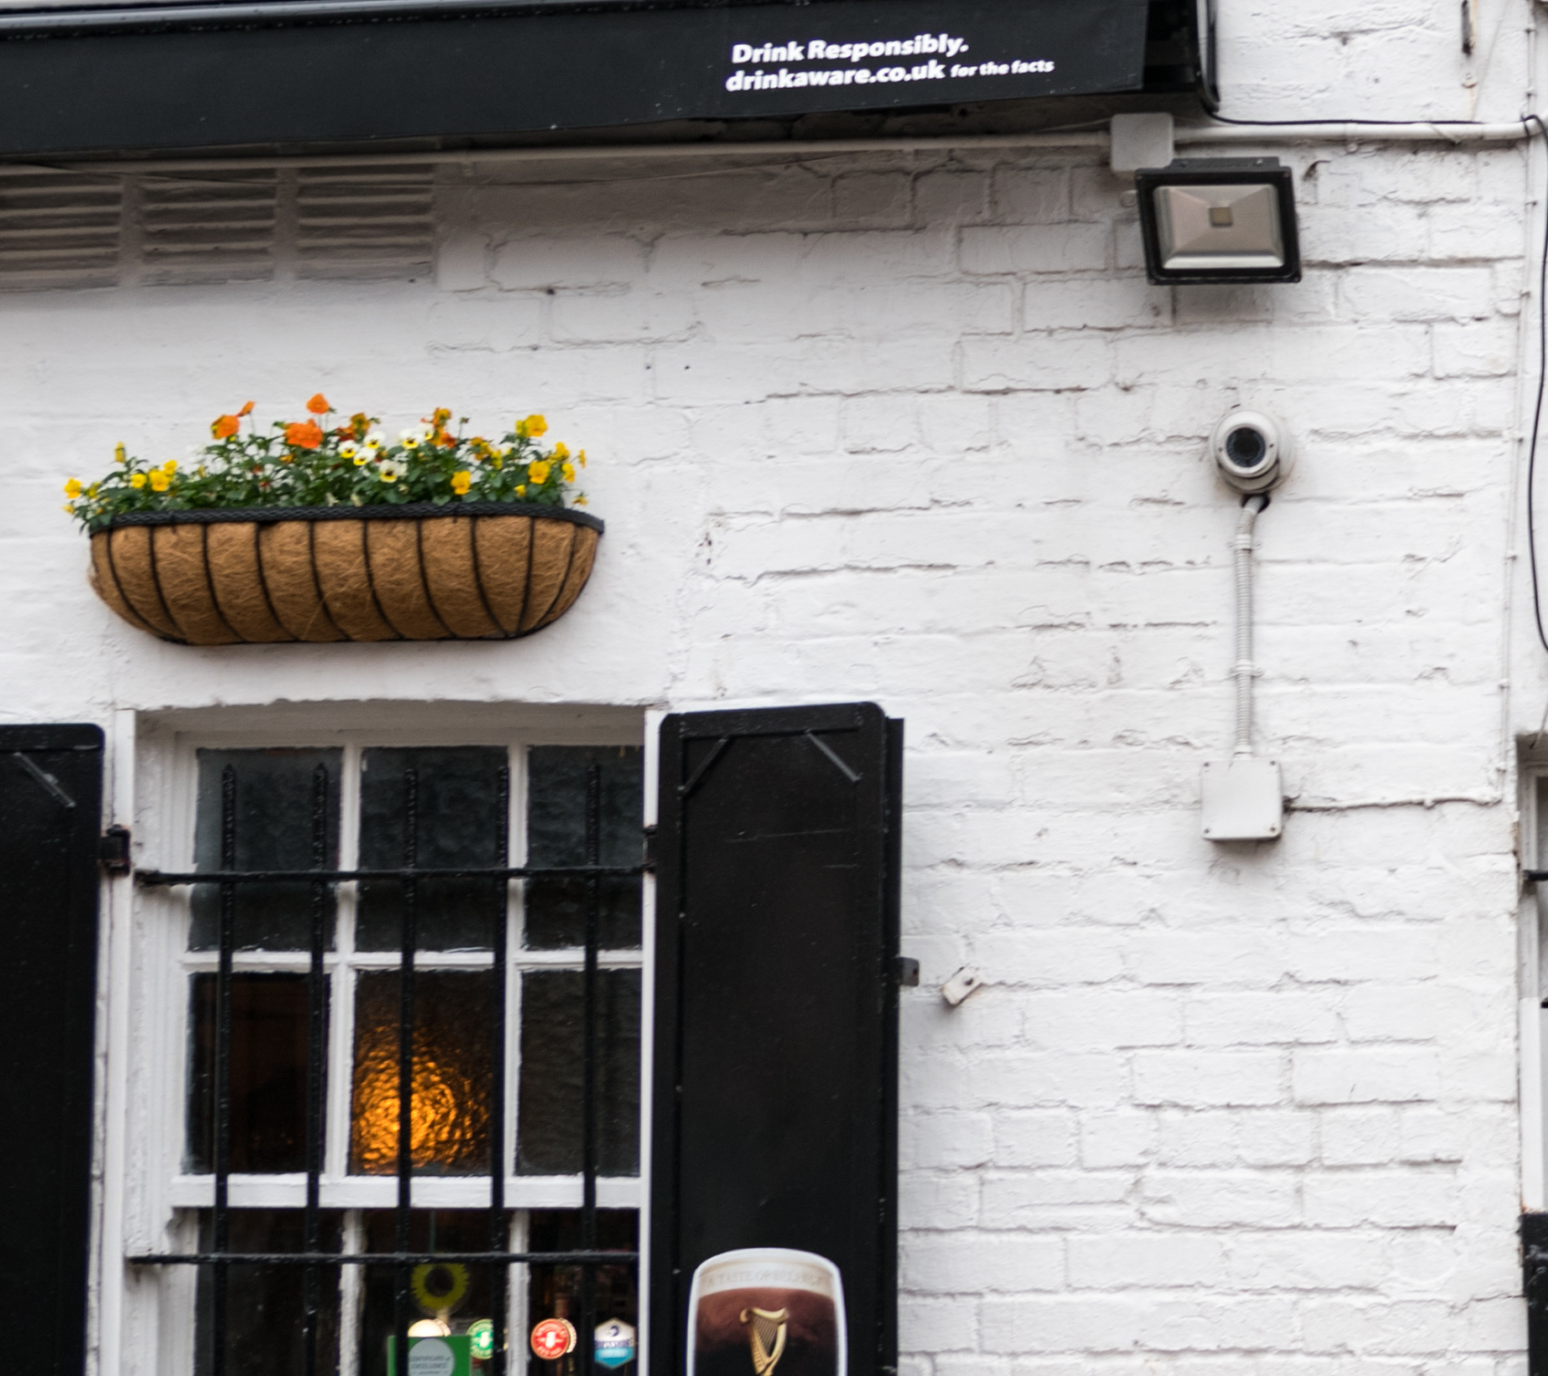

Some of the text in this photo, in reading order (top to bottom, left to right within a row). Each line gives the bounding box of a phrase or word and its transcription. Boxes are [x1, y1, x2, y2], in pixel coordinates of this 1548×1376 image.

[732, 33, 969, 64] Drink Responsibly.
[725, 58, 1055, 92] drinkaware.co.uk for the facts
